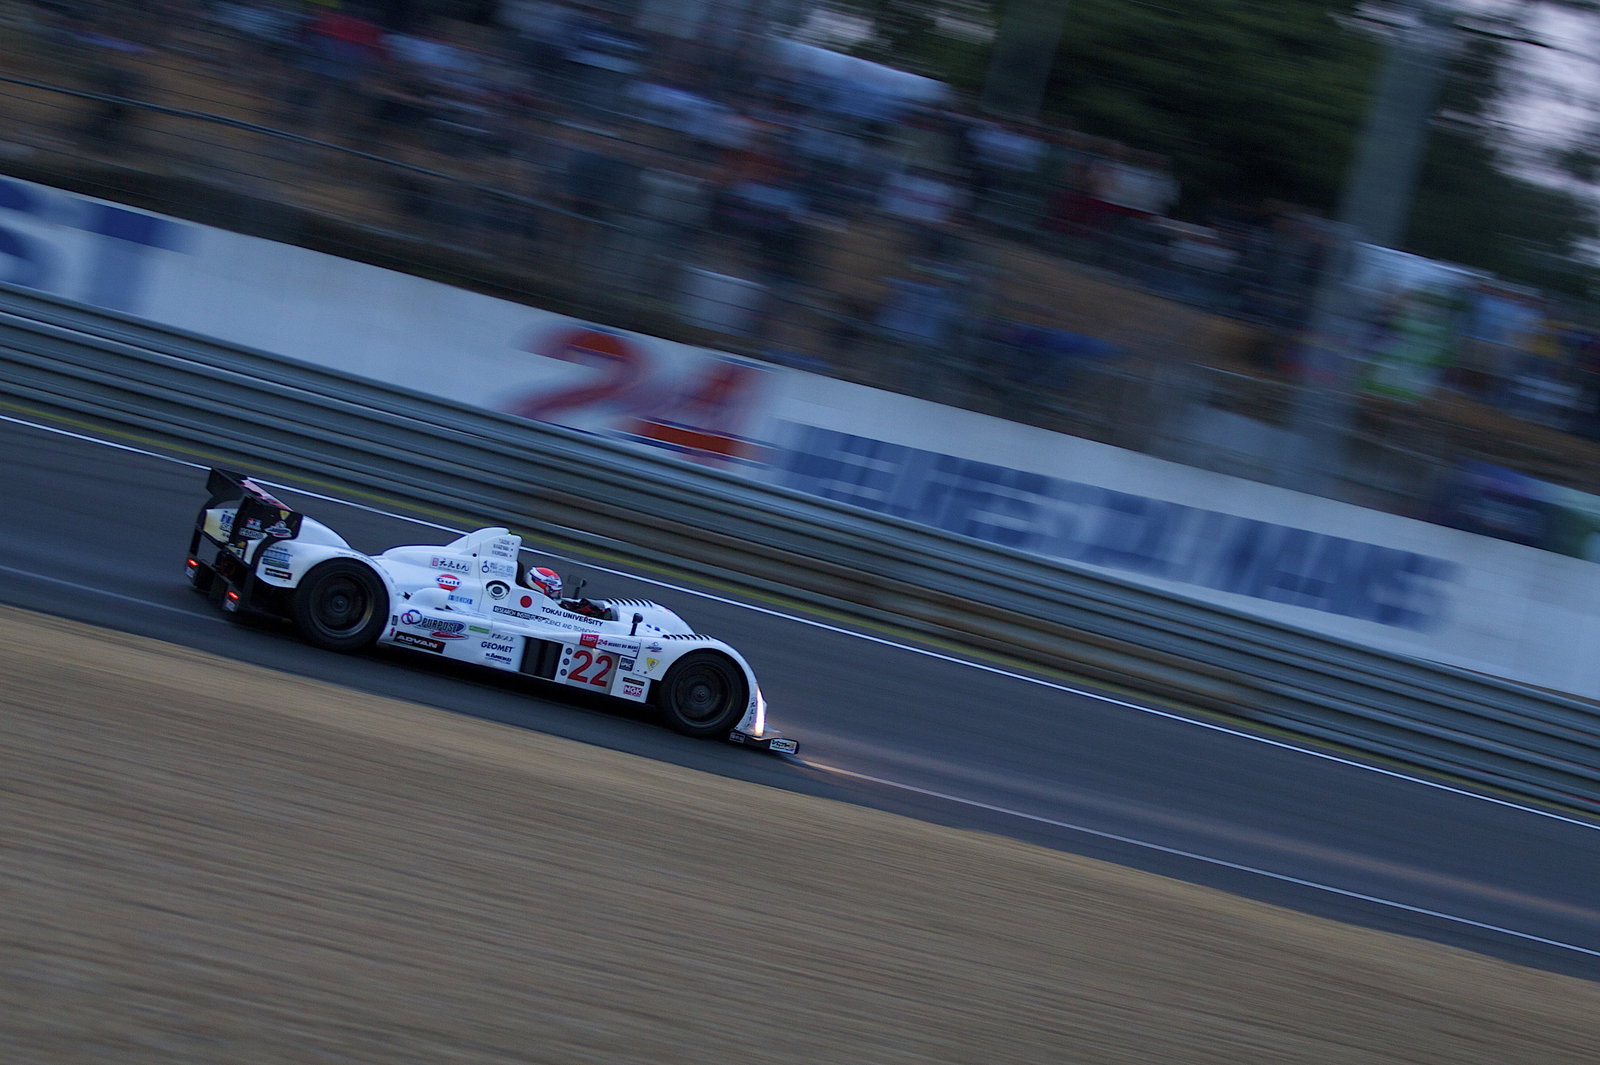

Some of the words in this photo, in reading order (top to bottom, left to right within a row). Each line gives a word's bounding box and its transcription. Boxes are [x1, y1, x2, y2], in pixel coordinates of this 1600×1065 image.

[505, 322, 778, 466] 24
[542, 606, 562, 617] TOKAI
[563, 611, 604, 627] UNIVERSITY
[422, 617, 459, 633] PURPOSE
[397, 634, 438, 649] ADVAN
[481, 641, 514, 653] GEOMET
[597, 638, 608, 646] 24
[568, 650, 613, 688] 22
[624, 685, 643, 697] NGK
